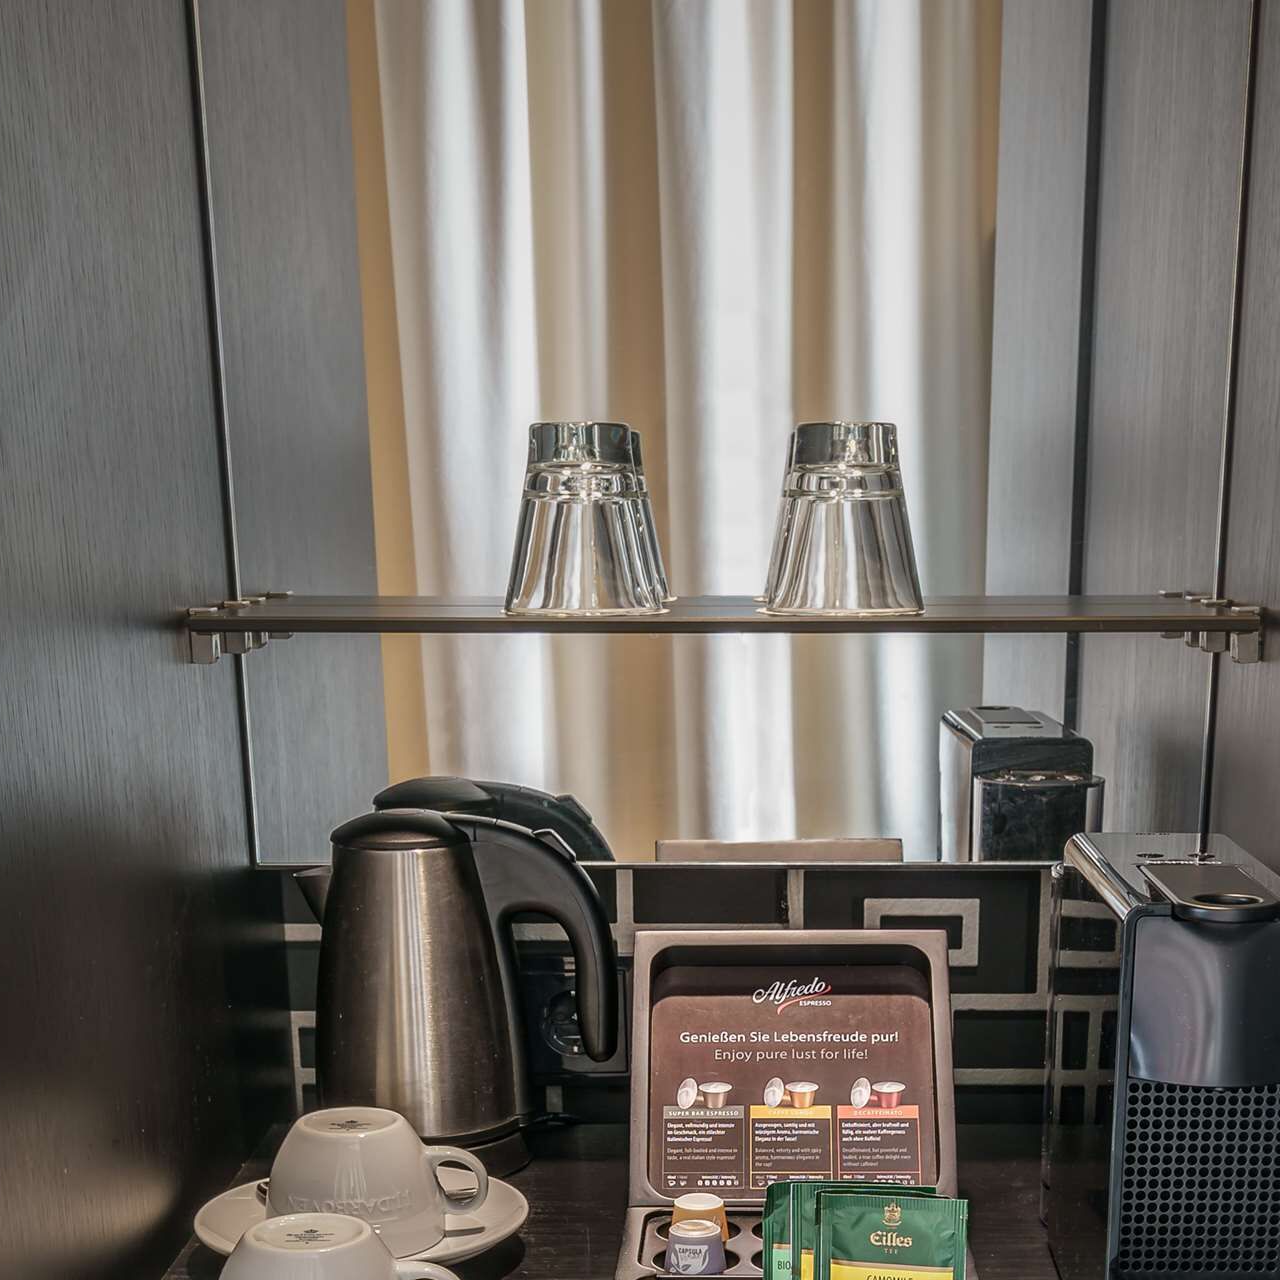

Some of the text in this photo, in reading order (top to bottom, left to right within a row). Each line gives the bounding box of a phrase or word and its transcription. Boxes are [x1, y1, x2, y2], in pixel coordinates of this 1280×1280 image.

[752, 977, 826, 1004] Alfredo
[680, 1031, 900, 1046] Genießen Sie Lebensfreude pur!
[714, 1049, 868, 1062] Enjoy pure lust for life!
[869, 1230, 913, 1247] Eilles
[777, 1261, 792, 1270] BIO
